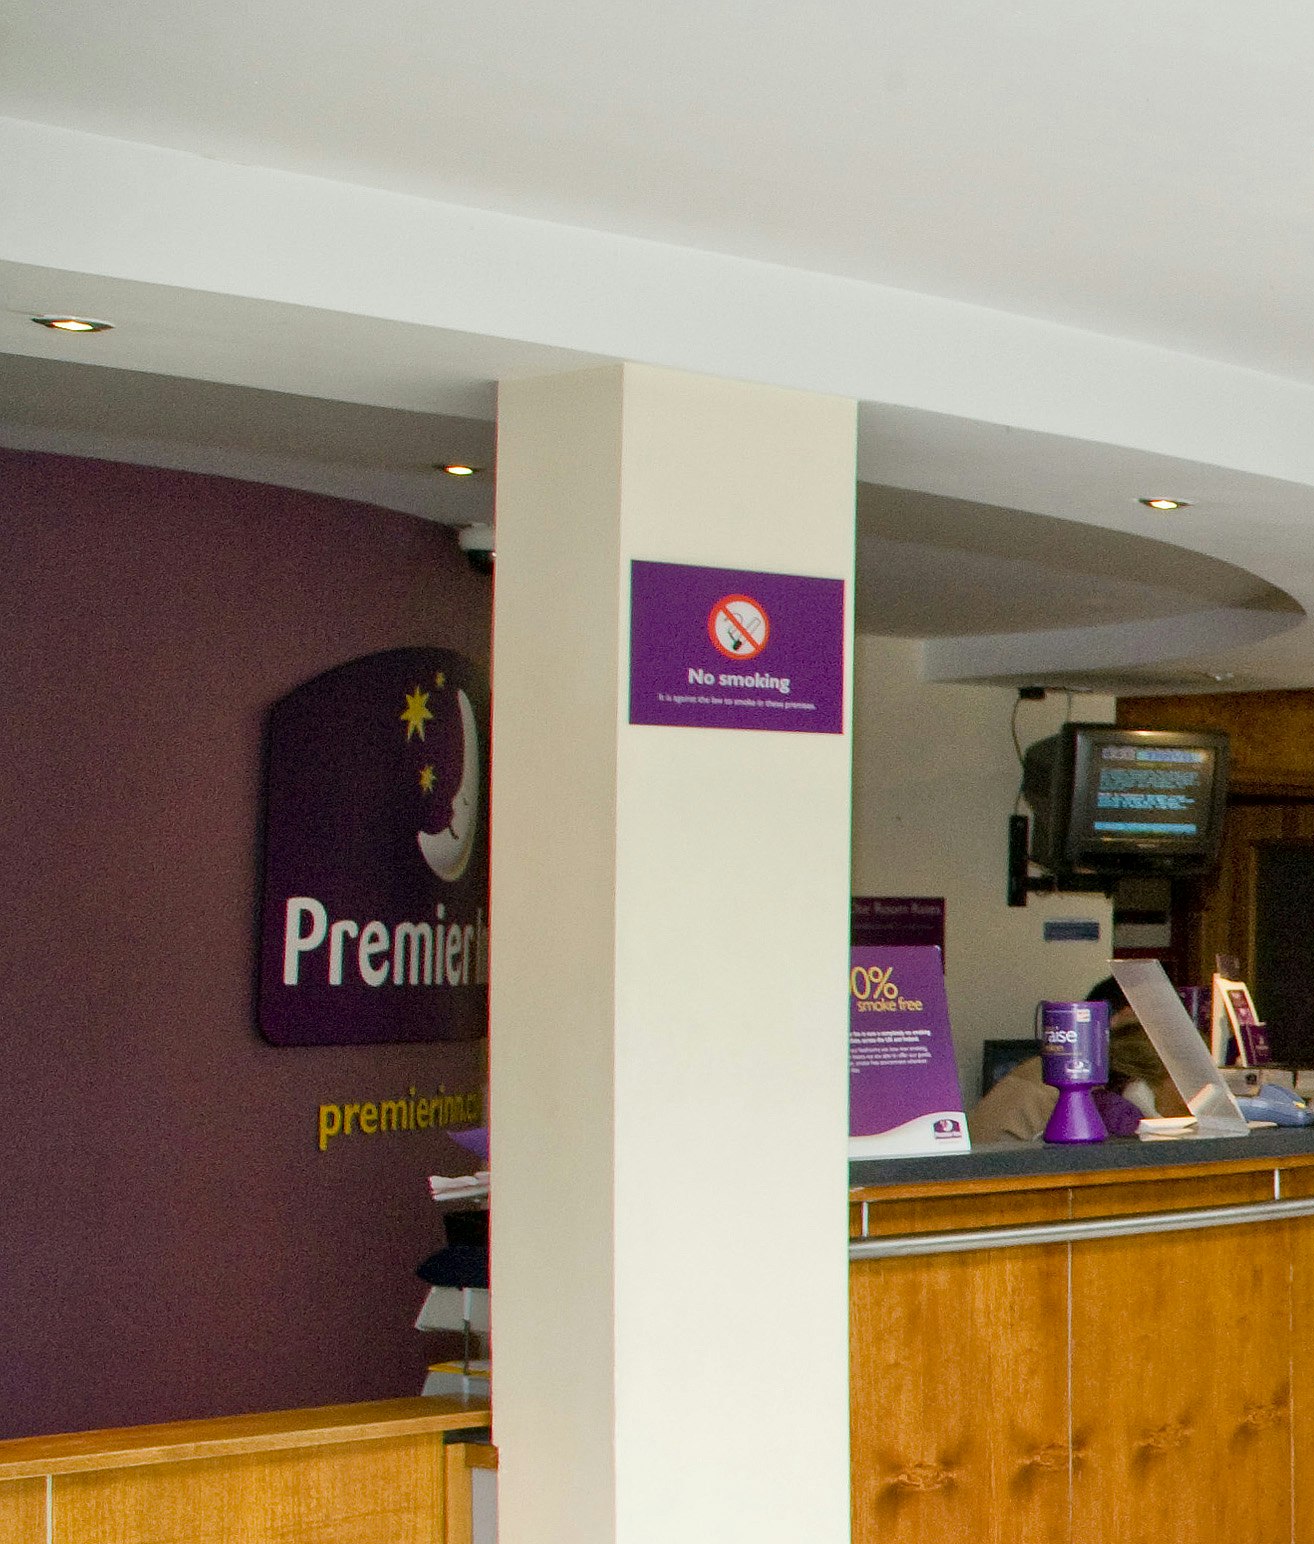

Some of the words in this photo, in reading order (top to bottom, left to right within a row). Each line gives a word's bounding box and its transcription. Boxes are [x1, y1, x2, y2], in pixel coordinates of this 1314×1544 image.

[688, 668, 715, 685] No
[719, 672, 791, 694] smoking
[283, 896, 474, 987] Premier
[850, 966, 899, 1000] 0%
[857, 998, 897, 1012] smoke
[898, 996, 923, 1011] free
